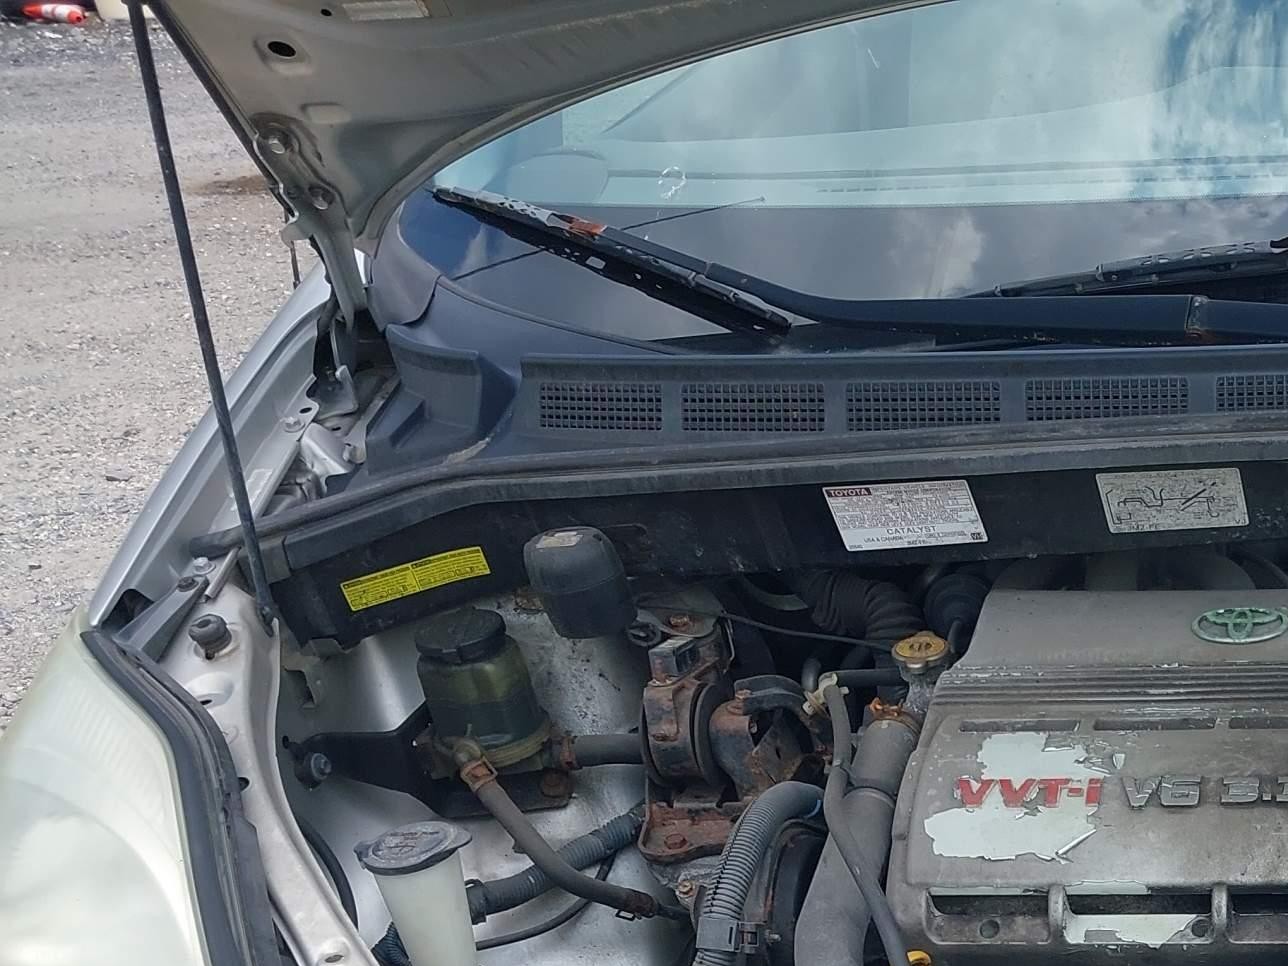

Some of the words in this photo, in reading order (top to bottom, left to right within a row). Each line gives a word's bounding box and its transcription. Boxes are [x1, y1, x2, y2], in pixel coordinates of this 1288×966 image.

[829, 487, 870, 497] TOYOTA
[886, 525, 937, 536] CATALYST
[1120, 775, 1202, 810] V6
